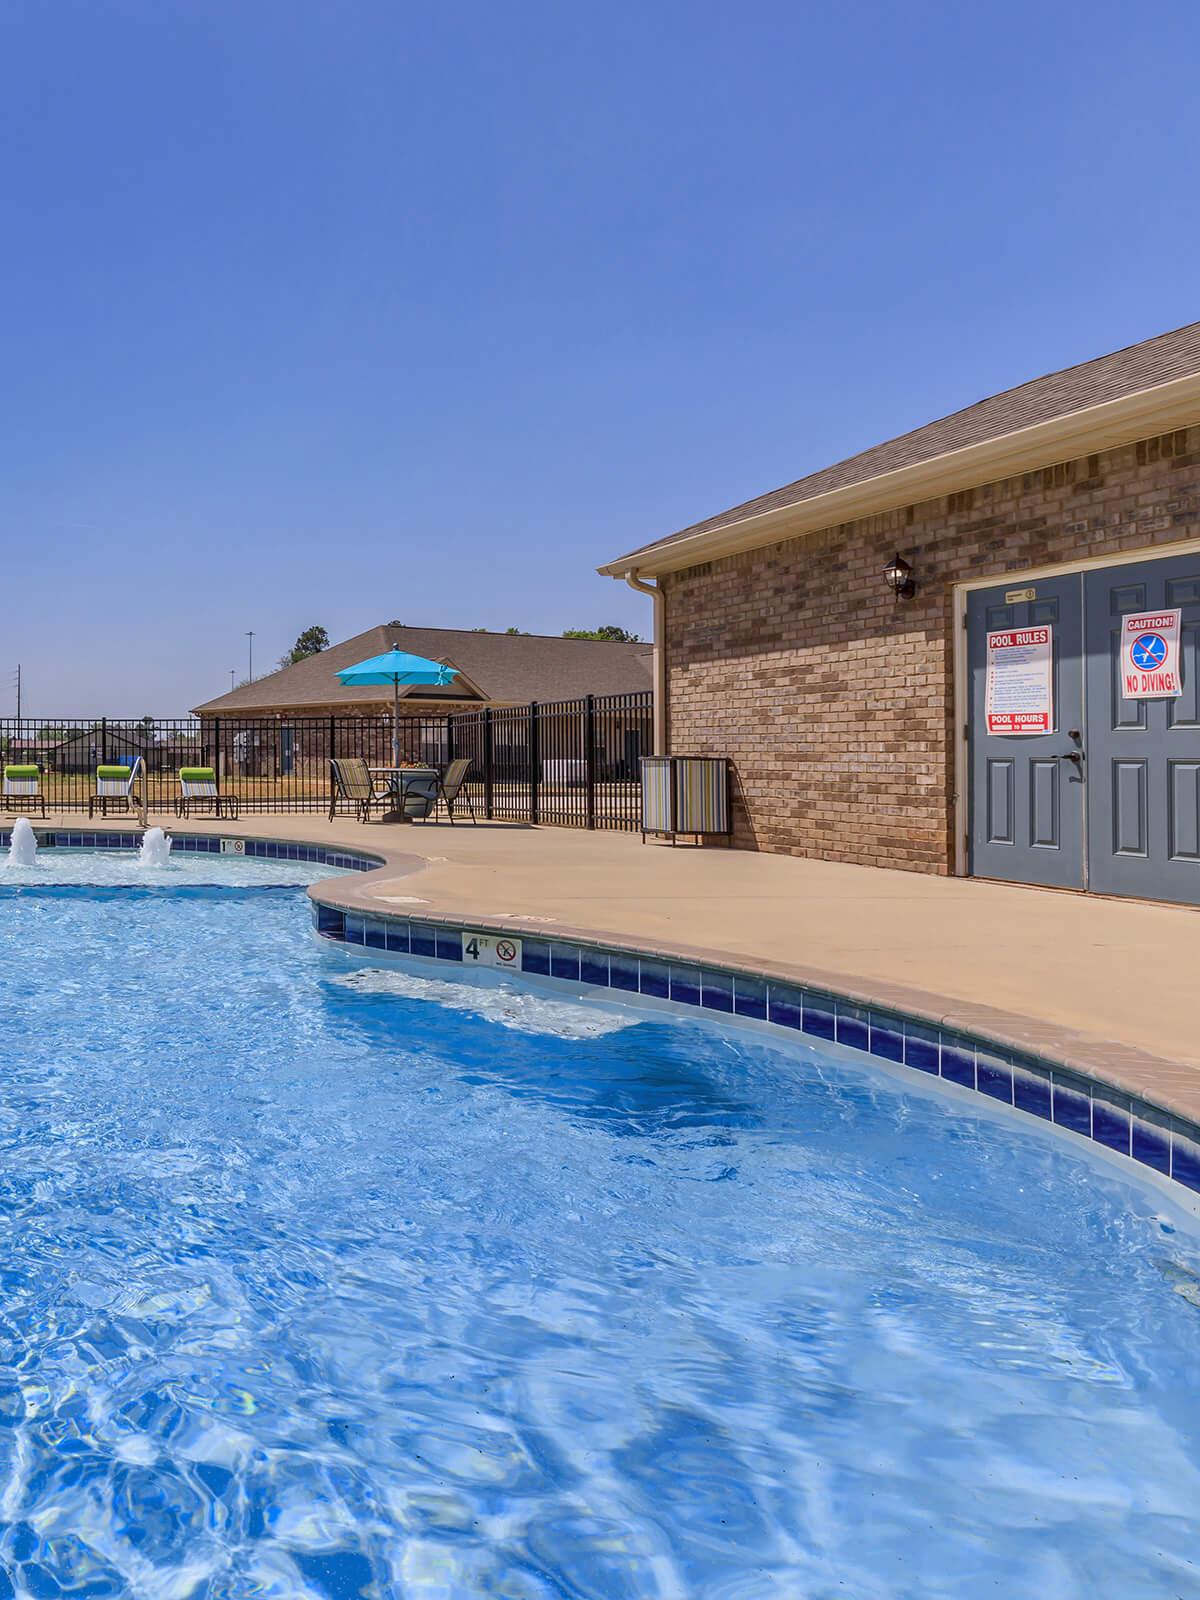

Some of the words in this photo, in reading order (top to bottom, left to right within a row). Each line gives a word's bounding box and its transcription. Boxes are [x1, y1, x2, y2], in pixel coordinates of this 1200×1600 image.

[1128, 617, 1173, 630] CAUTION!
[991, 635, 1014, 647] POOL
[1016, 631, 1047, 645] RULES
[1126, 675, 1139, 693] NO
[1141, 672, 1176, 692] DIVING!
[991, 715, 1013, 724] POOL
[1014, 714, 1044, 723] HOURS
[465, 938, 480, 960] 4
